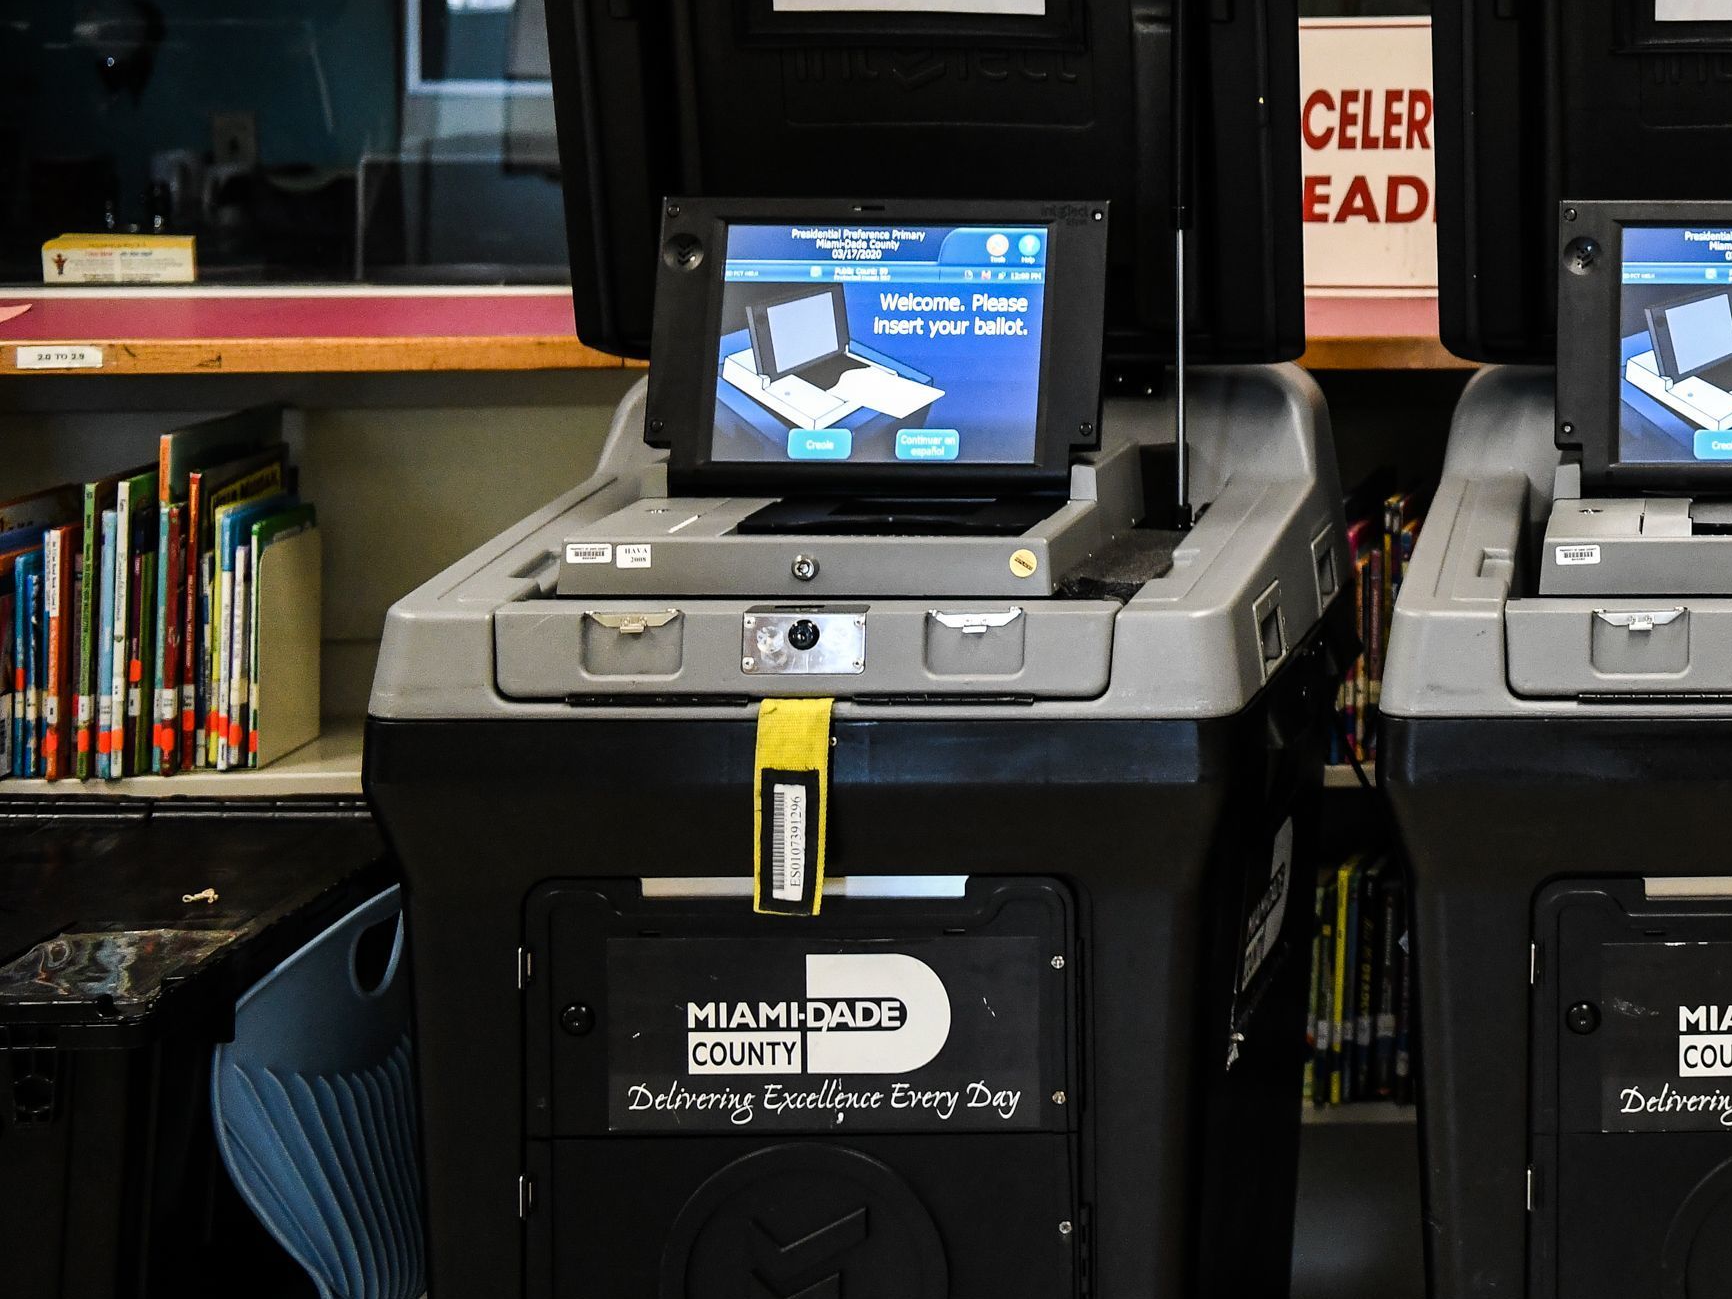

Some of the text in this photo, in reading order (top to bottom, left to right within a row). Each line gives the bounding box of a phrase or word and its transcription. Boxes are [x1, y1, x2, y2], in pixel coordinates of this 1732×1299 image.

[1302, 88, 1433, 151] CELER
[1302, 174, 1437, 224] EAD
[791, 228, 926, 244] Presidential Preference Primary
[816, 238, 900, 252] Miami-Dade County
[1684, 231, 1732, 243] Presidential
[831, 249, 883, 261] 03/17/2020
[879, 293, 1029, 313] Welcome. Please
[873, 316, 1029, 339] insert your ballot.
[805, 439, 835, 451] Creole
[900, 434, 942, 446] Continuar
[687, 1001, 901, 1030] MIAMI-DADE
[691, 1041, 798, 1067] COUNTY
[627, 1078, 1023, 1126] Delivering Excellence Every Day
